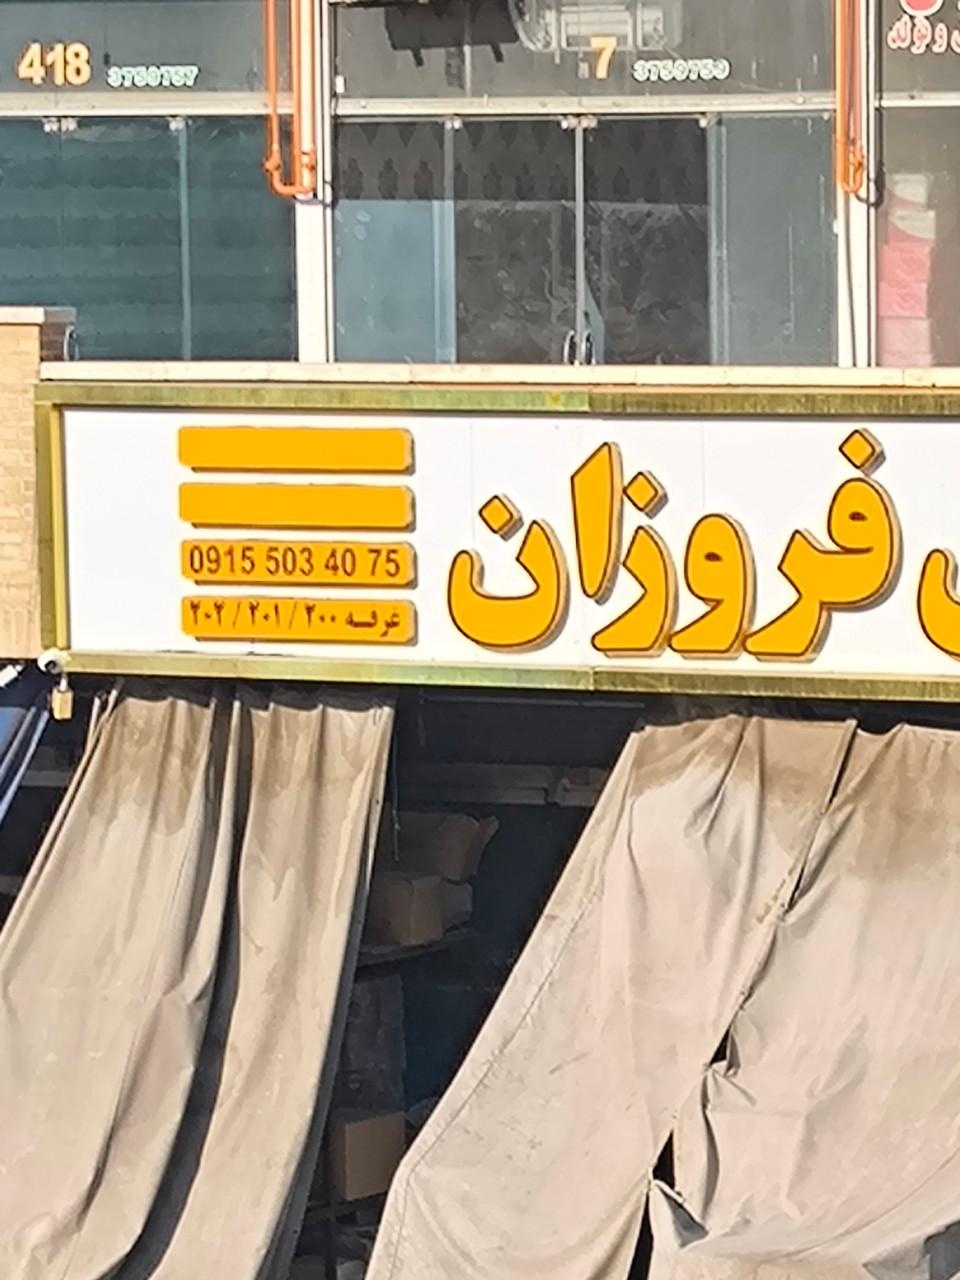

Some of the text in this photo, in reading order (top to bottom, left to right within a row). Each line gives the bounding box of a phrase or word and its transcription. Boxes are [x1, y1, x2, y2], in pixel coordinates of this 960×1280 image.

[17, 41, 92, 86] 418
[189, 545, 401, 577] 0915 503 40 75
[447, 428, 902, 662] فروزان
